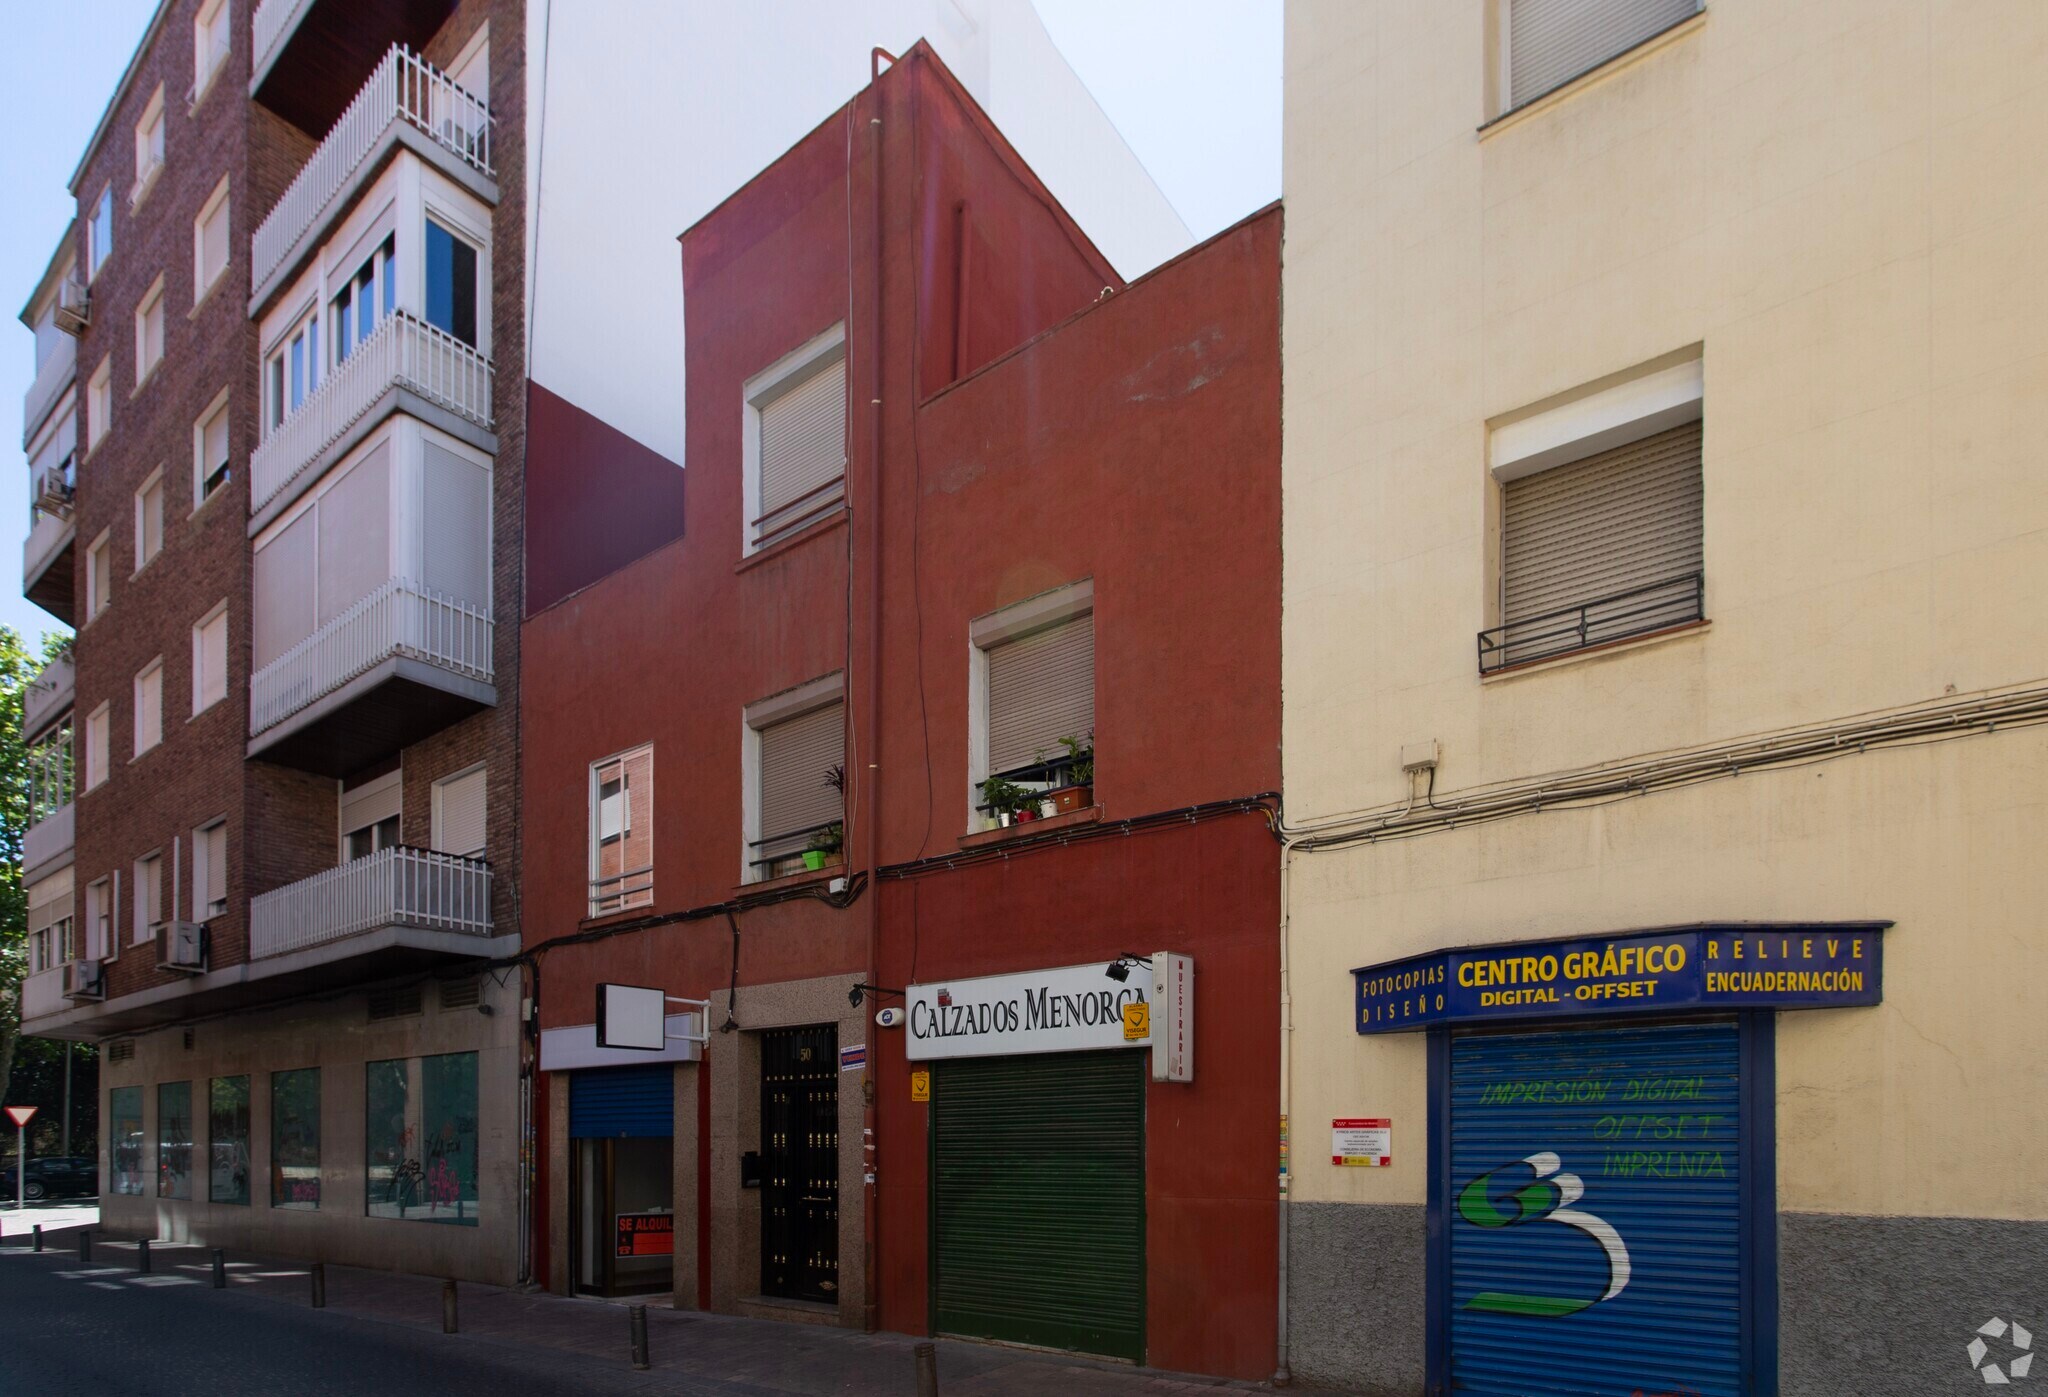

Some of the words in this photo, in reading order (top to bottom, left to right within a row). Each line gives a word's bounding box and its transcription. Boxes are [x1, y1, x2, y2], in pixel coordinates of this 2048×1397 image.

[1707, 939, 1864, 960] RELIEVE
[1457, 954, 1559, 988] CENTRO
[1562, 944, 1687, 980] GRÁFICO
[1362, 964, 1445, 999] FOTOCOPIAS
[1480, 987, 1560, 1007] DIGITAL
[1574, 980, 1659, 1001] OFFSET
[1706, 967, 1864, 993] ENCUADERNACIÓN
[910, 999, 1019, 1040] CALZADOS
[1362, 994, 1444, 1024] DISEÑO
[800, 1047, 812, 1062] 50
[619, 1217, 632, 1231] SE
